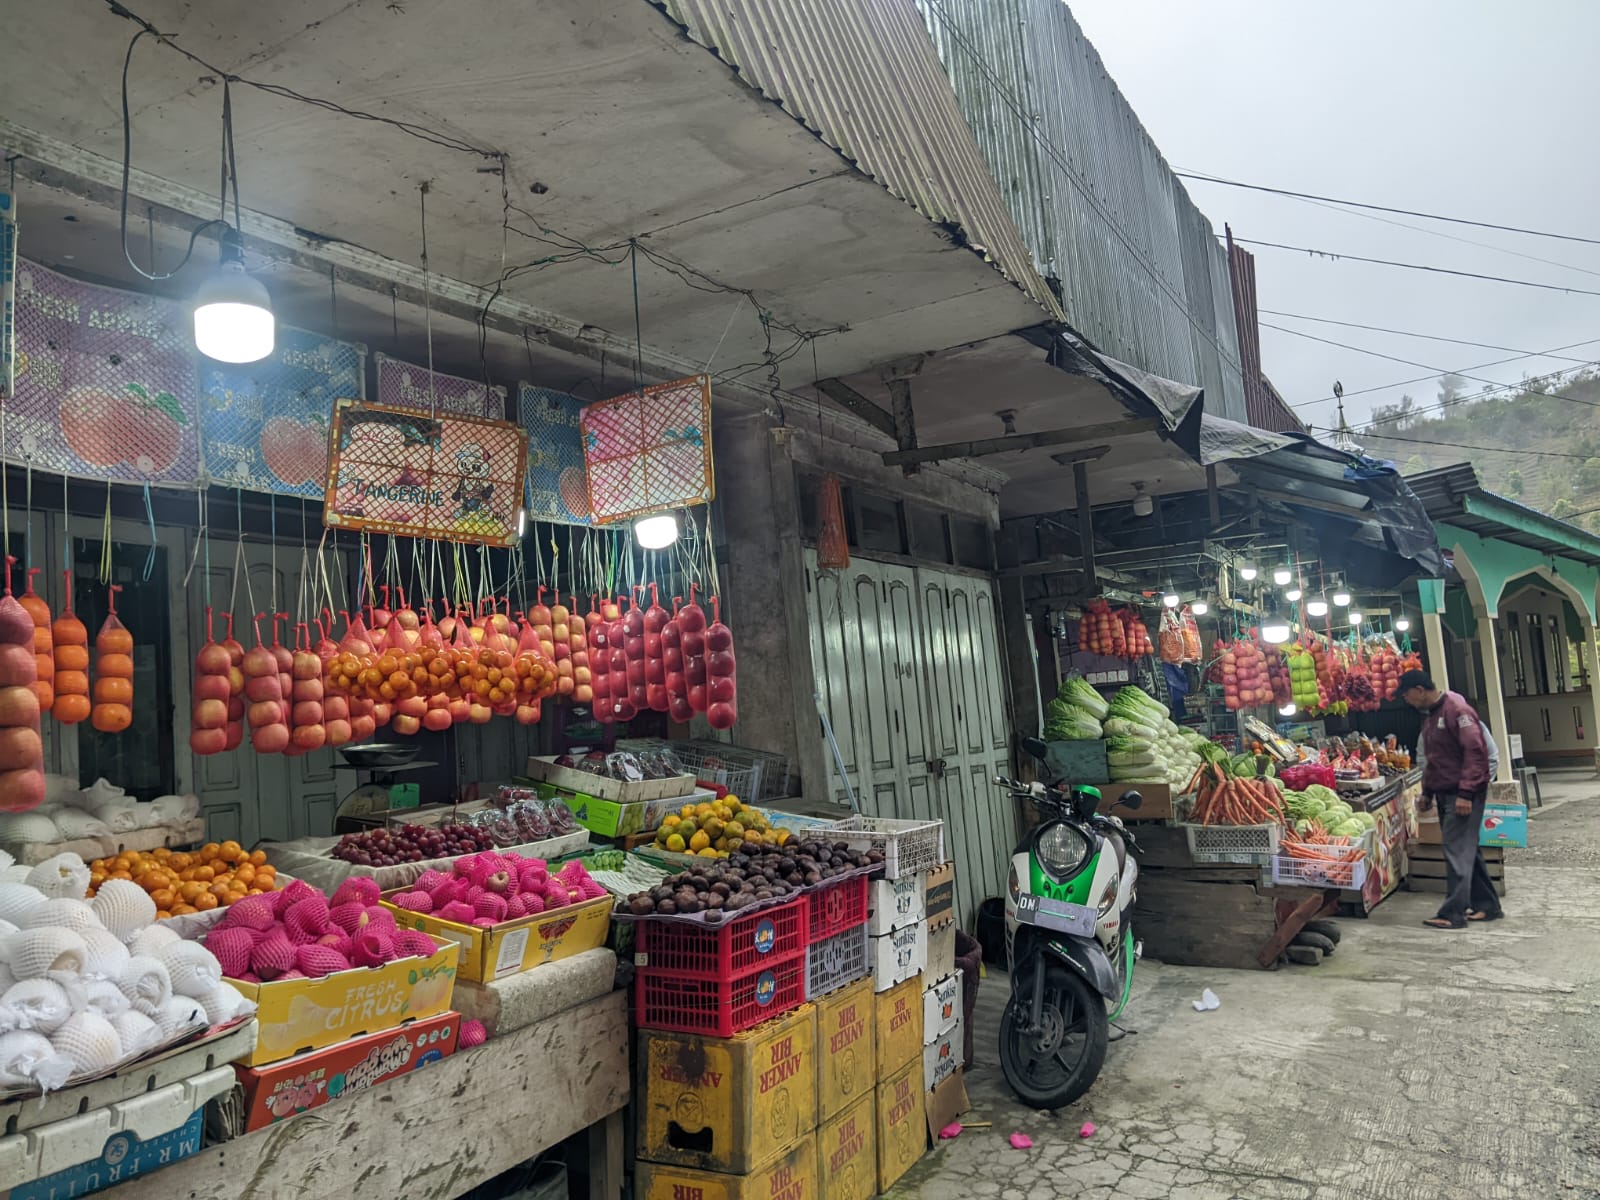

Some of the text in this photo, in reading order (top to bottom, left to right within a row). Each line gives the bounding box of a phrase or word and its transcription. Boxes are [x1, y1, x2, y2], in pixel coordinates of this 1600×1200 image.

[353, 478, 445, 507] TANGERINE
[893, 928, 916, 949] Sunkist
[346, 979, 397, 1003] FRESH
[325, 991, 404, 1030] CITRUS
[838, 1004, 856, 1029] BIR
[894, 997, 905, 1014] BIR
[771, 1036, 793, 1064] BIR
[760, 1051, 803, 1094] ANKER
[895, 1078, 909, 1101] BIR
[838, 1116, 856, 1145] BIR
[770, 1166, 793, 1196] BIR
